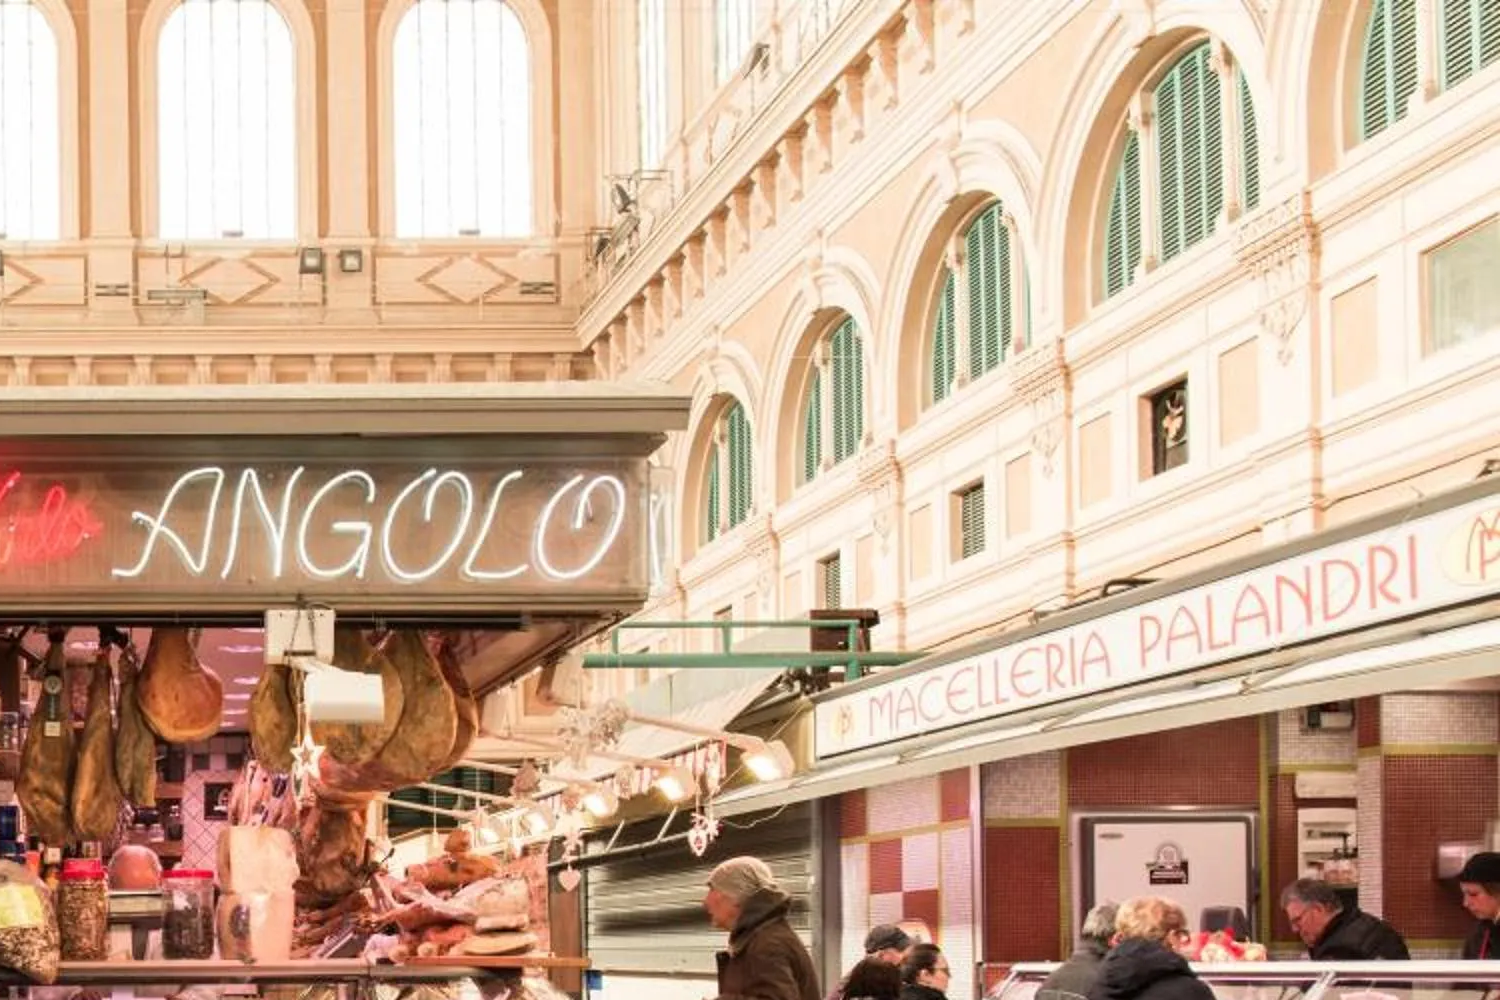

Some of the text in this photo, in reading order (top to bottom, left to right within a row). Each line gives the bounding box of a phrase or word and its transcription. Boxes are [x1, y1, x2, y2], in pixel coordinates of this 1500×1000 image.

[111, 466, 626, 580] ANGOLO
[868, 534, 1419, 737] MACELLERIA PALANDRI
